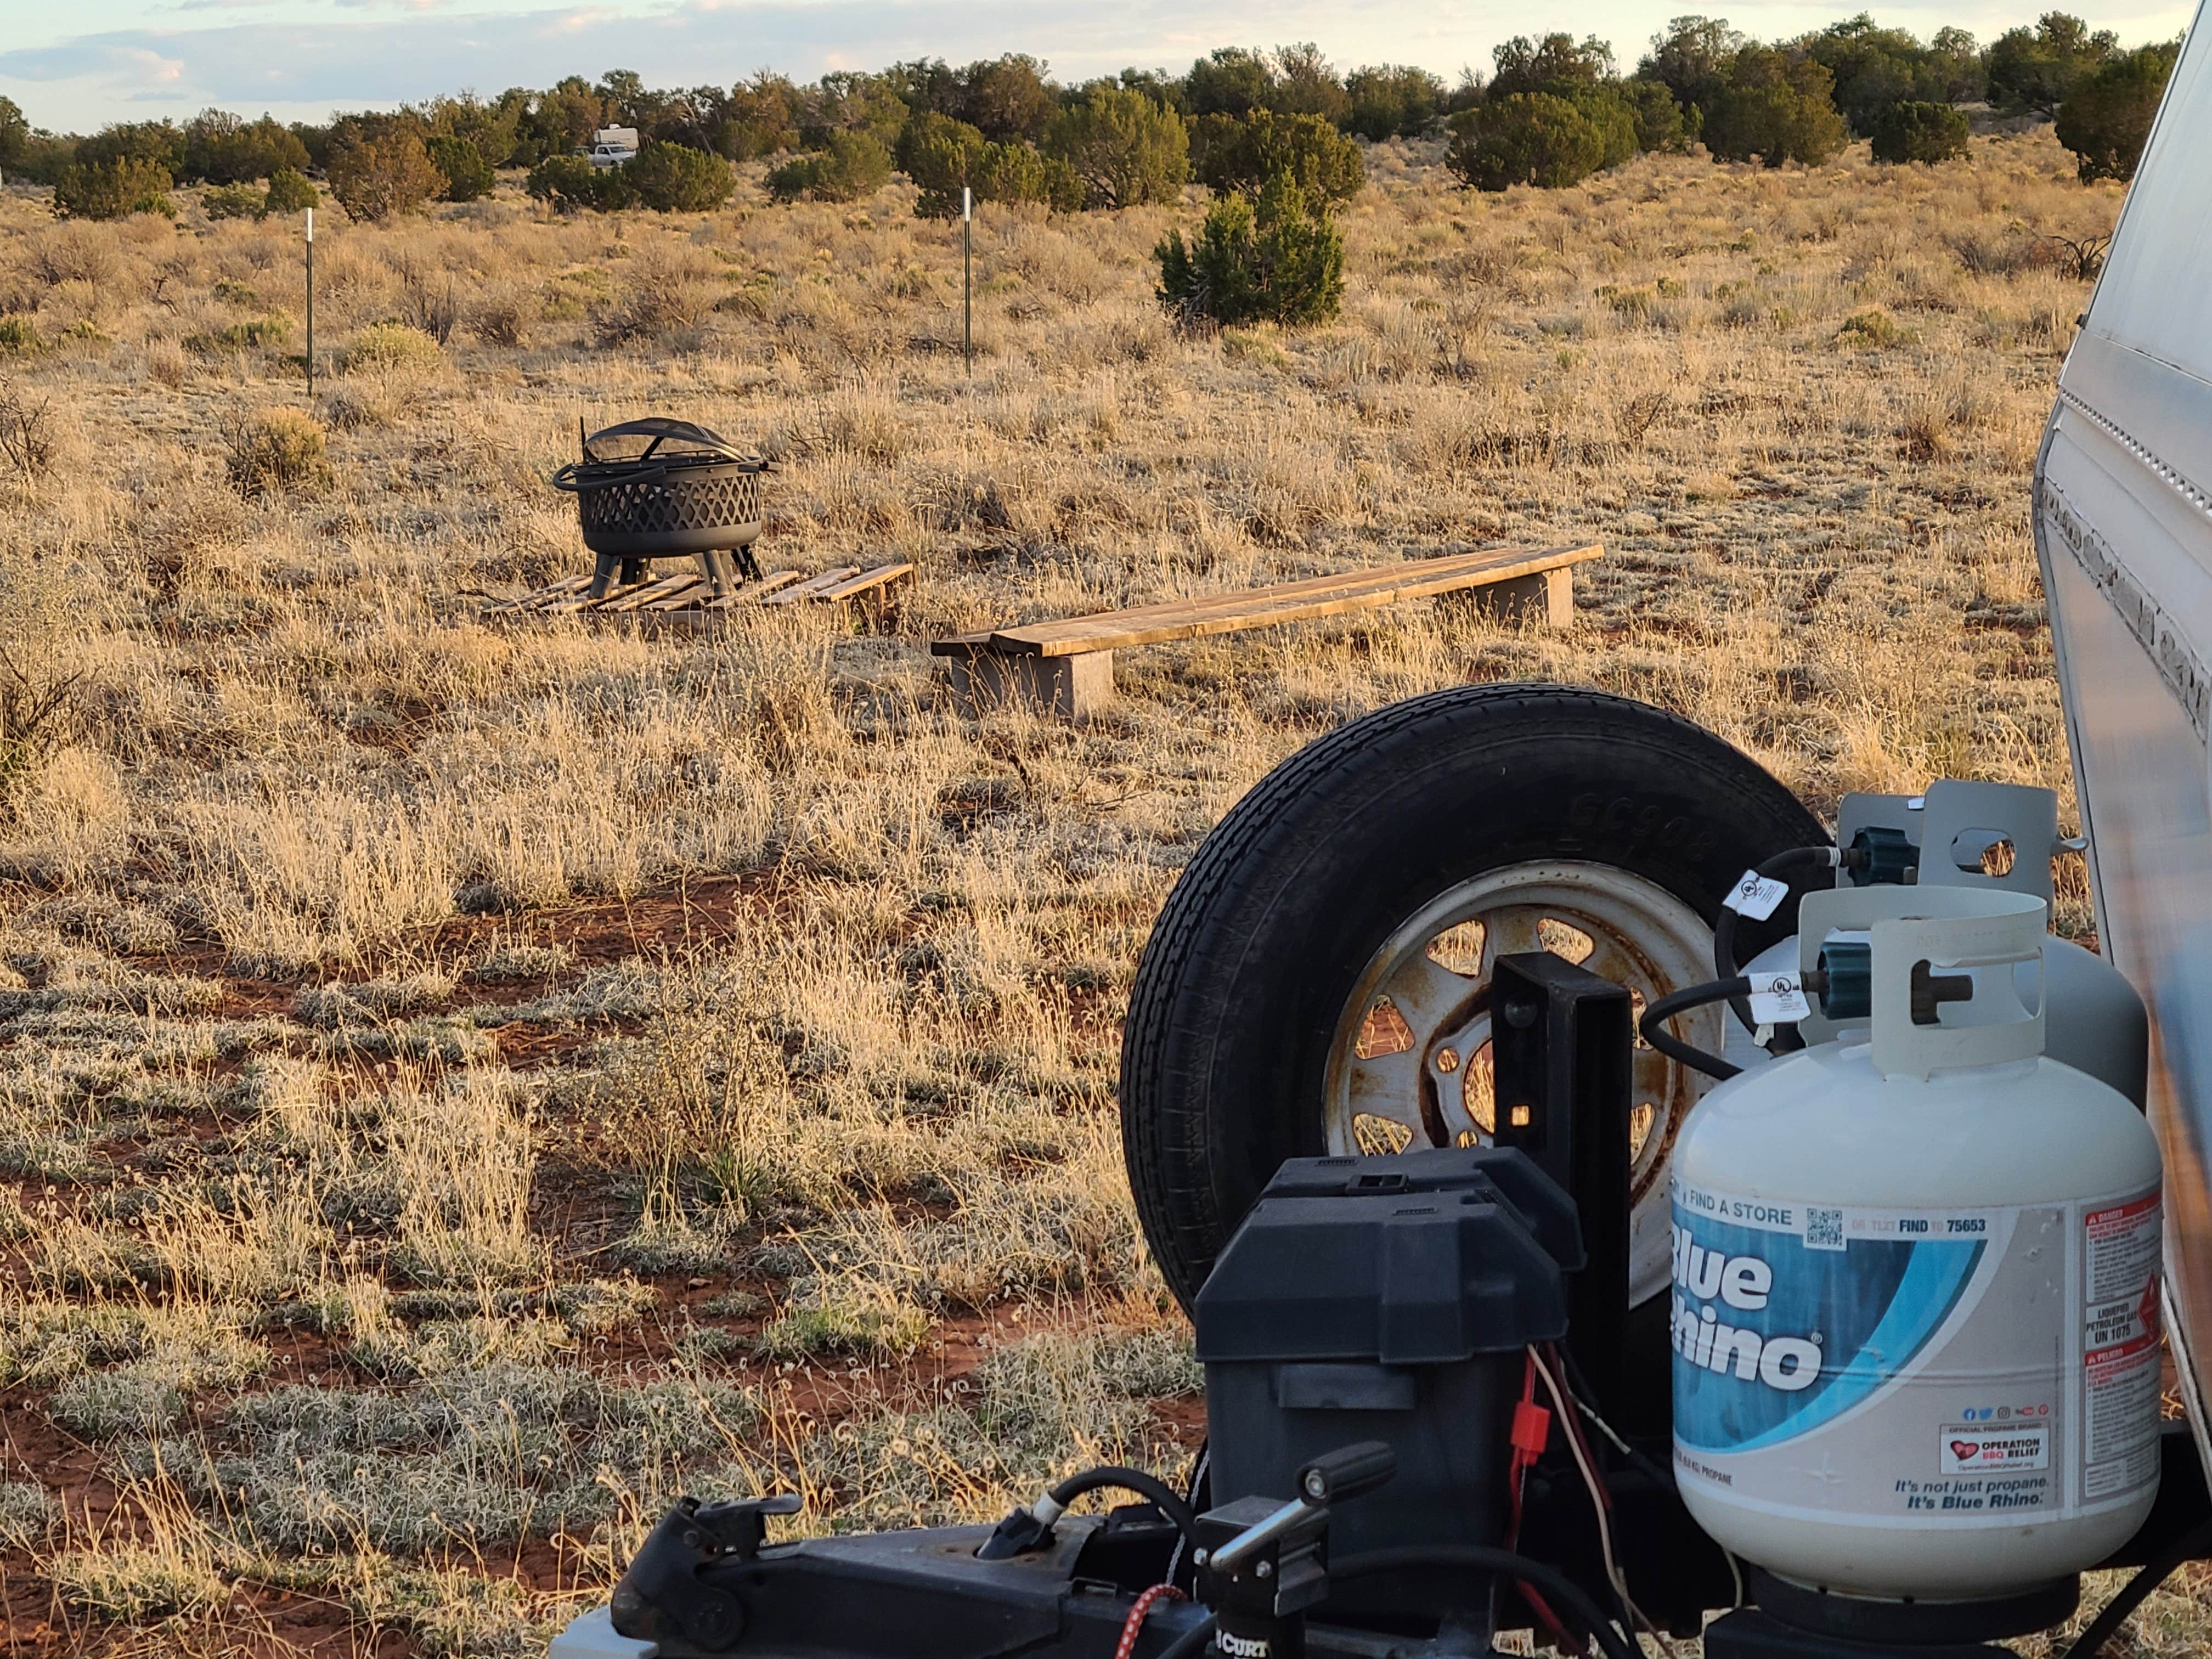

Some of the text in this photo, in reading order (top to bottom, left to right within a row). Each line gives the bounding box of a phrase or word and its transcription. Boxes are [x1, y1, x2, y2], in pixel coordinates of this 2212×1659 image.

[1690, 1189, 1793, 1226] FIND A STORE
[2098, 1209, 2124, 1223] DANGER
[1899, 1220, 1928, 1232] FIND
[1947, 1219, 1986, 1232] 75653
[2098, 1302, 2129, 1319] LIQUEFIED
[2086, 1315, 2126, 1332] PETROLEUM
[1671, 1293, 1822, 1391] hino
[2095, 1323, 2131, 1344] UN 1075
[2097, 1347, 2123, 1362] PELIGRO
[1982, 1438, 2040, 1450] OPERATION
[1983, 1448, 2040, 1460] BBQ RELIEF
[1702, 1465, 1732, 1486] PROPANE
[1895, 1477, 2050, 1494] It's not just propane.
[1908, 1496, 1936, 1509] It's
[1942, 1496, 1983, 1509] Blue
[1222, 1632, 1267, 1657] CURT
